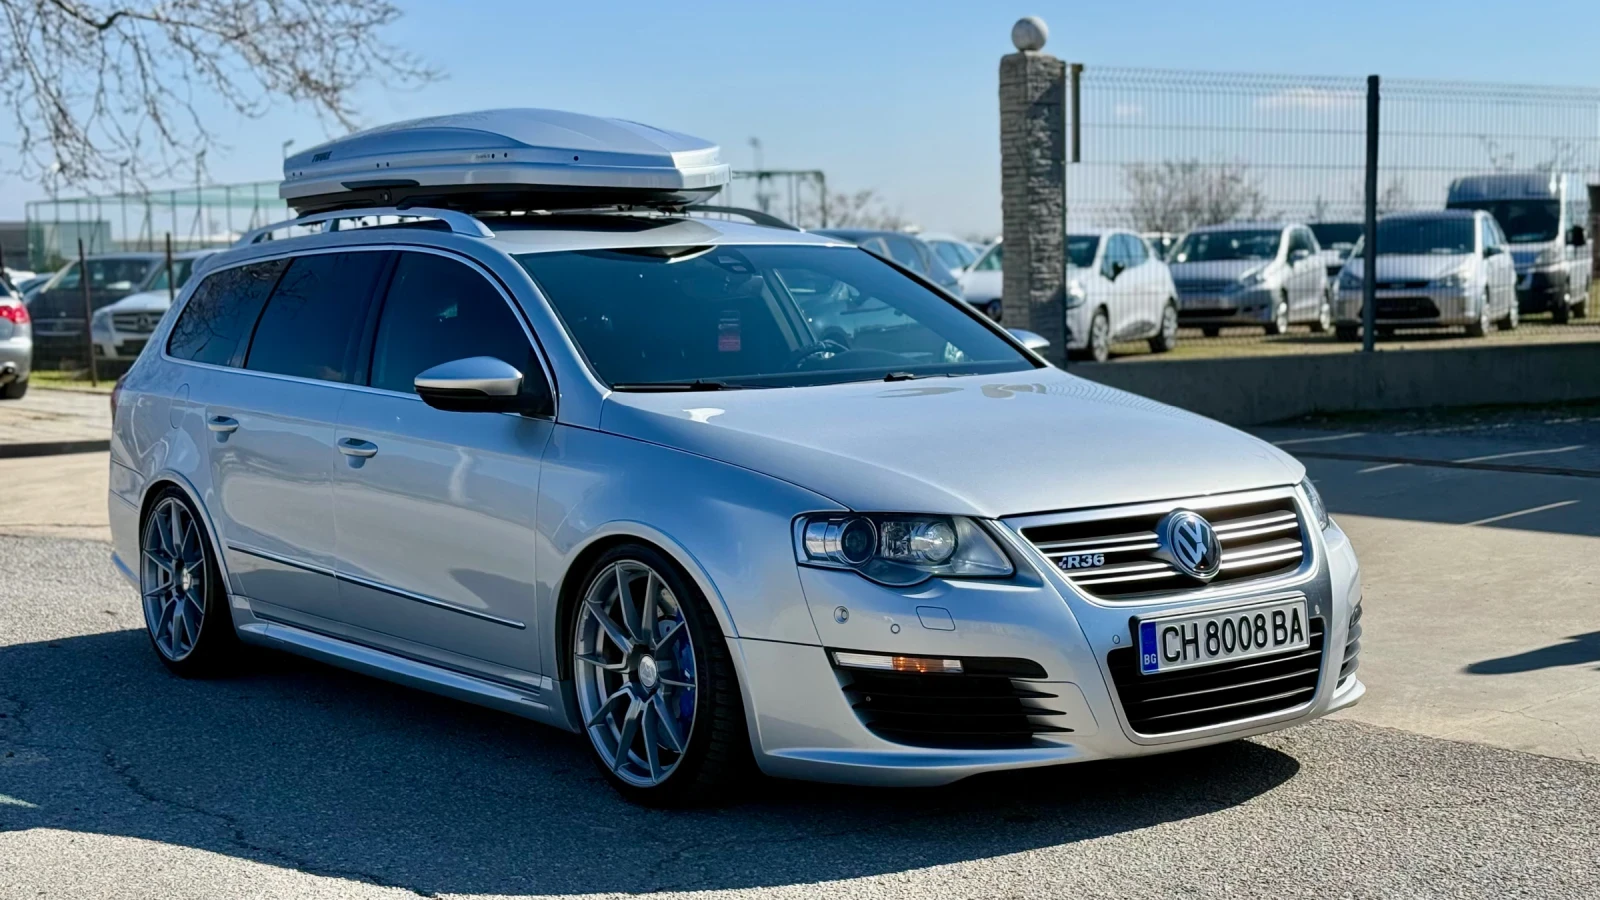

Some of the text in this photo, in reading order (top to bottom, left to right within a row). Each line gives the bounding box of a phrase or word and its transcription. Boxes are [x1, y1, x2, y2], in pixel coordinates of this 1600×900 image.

[1066, 553, 1105, 569] R36
[1162, 607, 1304, 662] CH 8008 BA
[1144, 653, 1157, 666] BG
